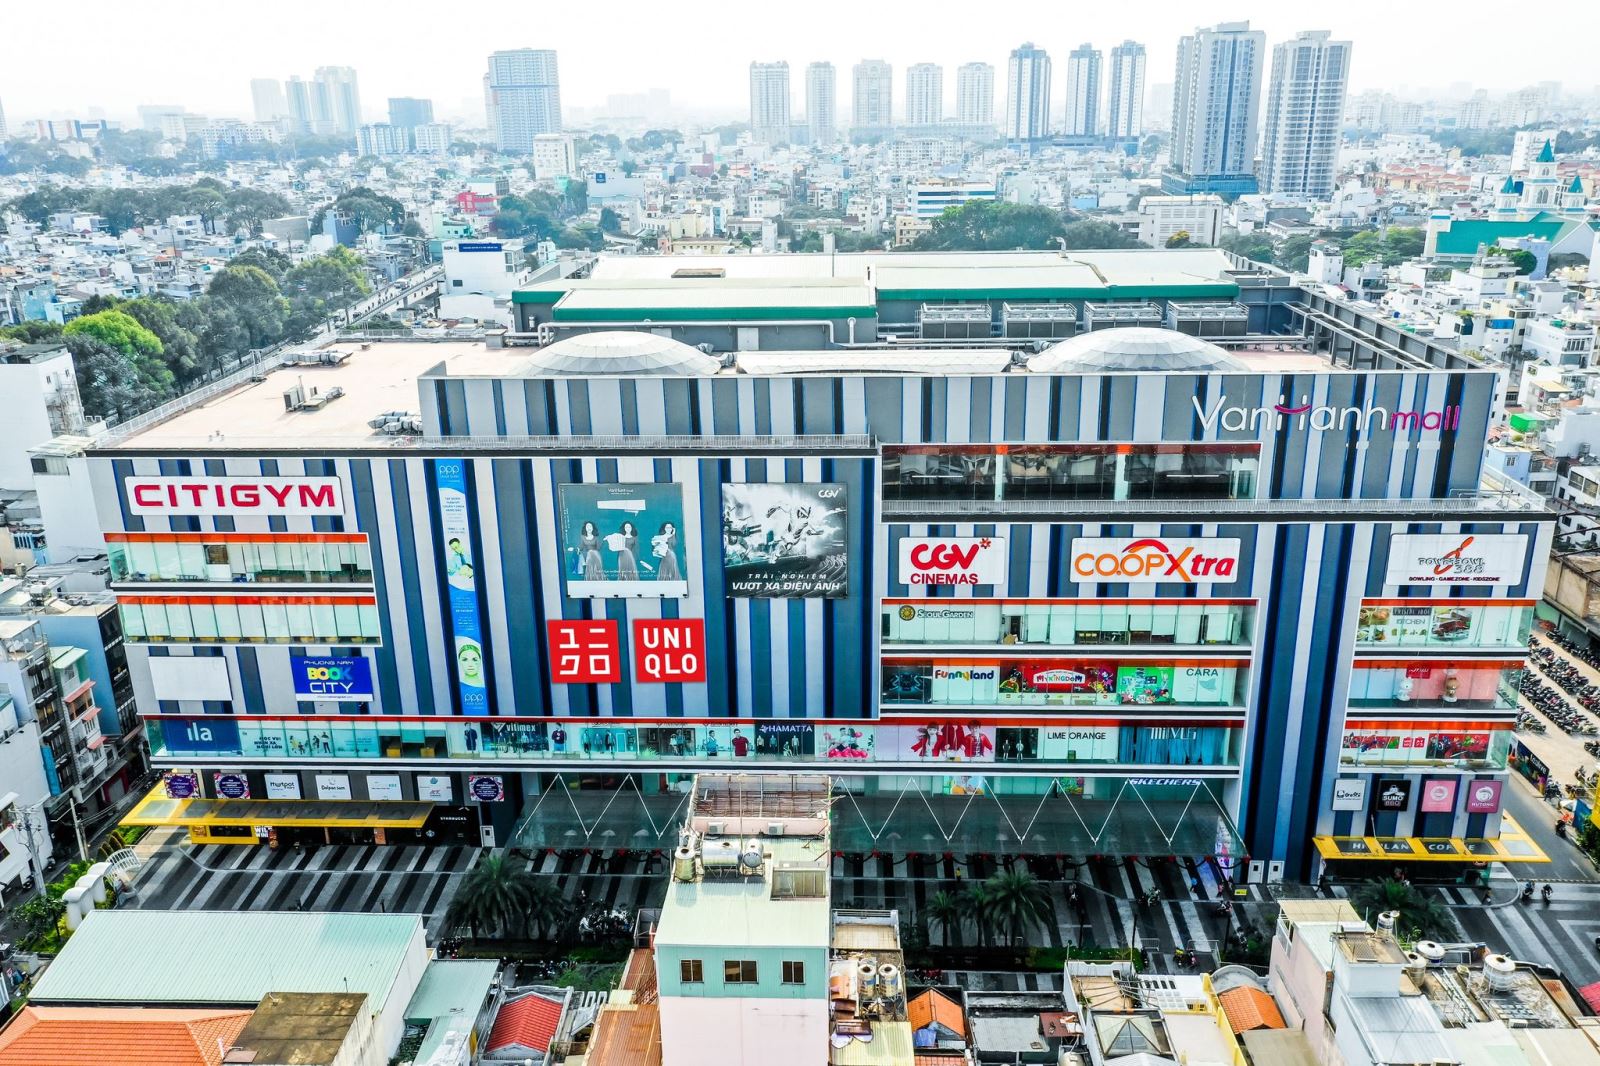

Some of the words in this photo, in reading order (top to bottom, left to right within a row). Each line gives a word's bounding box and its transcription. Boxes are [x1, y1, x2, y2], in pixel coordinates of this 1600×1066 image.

[133, 484, 336, 508] CITIGYM
[817, 489, 839, 498] CGV
[910, 543, 980, 571] CGV
[910, 573, 978, 585] CINEMAS
[765, 582, 780, 590] XA
[642, 627, 692, 649] UNI
[644, 653, 698, 678] QLO
[306, 667, 353, 680] BOOK
[935, 669, 995, 681] Funnyland
[1186, 668, 1219, 677] CARA
[309, 682, 354, 693] CITY
[506, 723, 536, 732] vitimex
[768, 725, 813, 733] HAMATTA
[1069, 732, 1106, 740] ORANGE
[1129, 778, 1201, 786] SKECHERS
